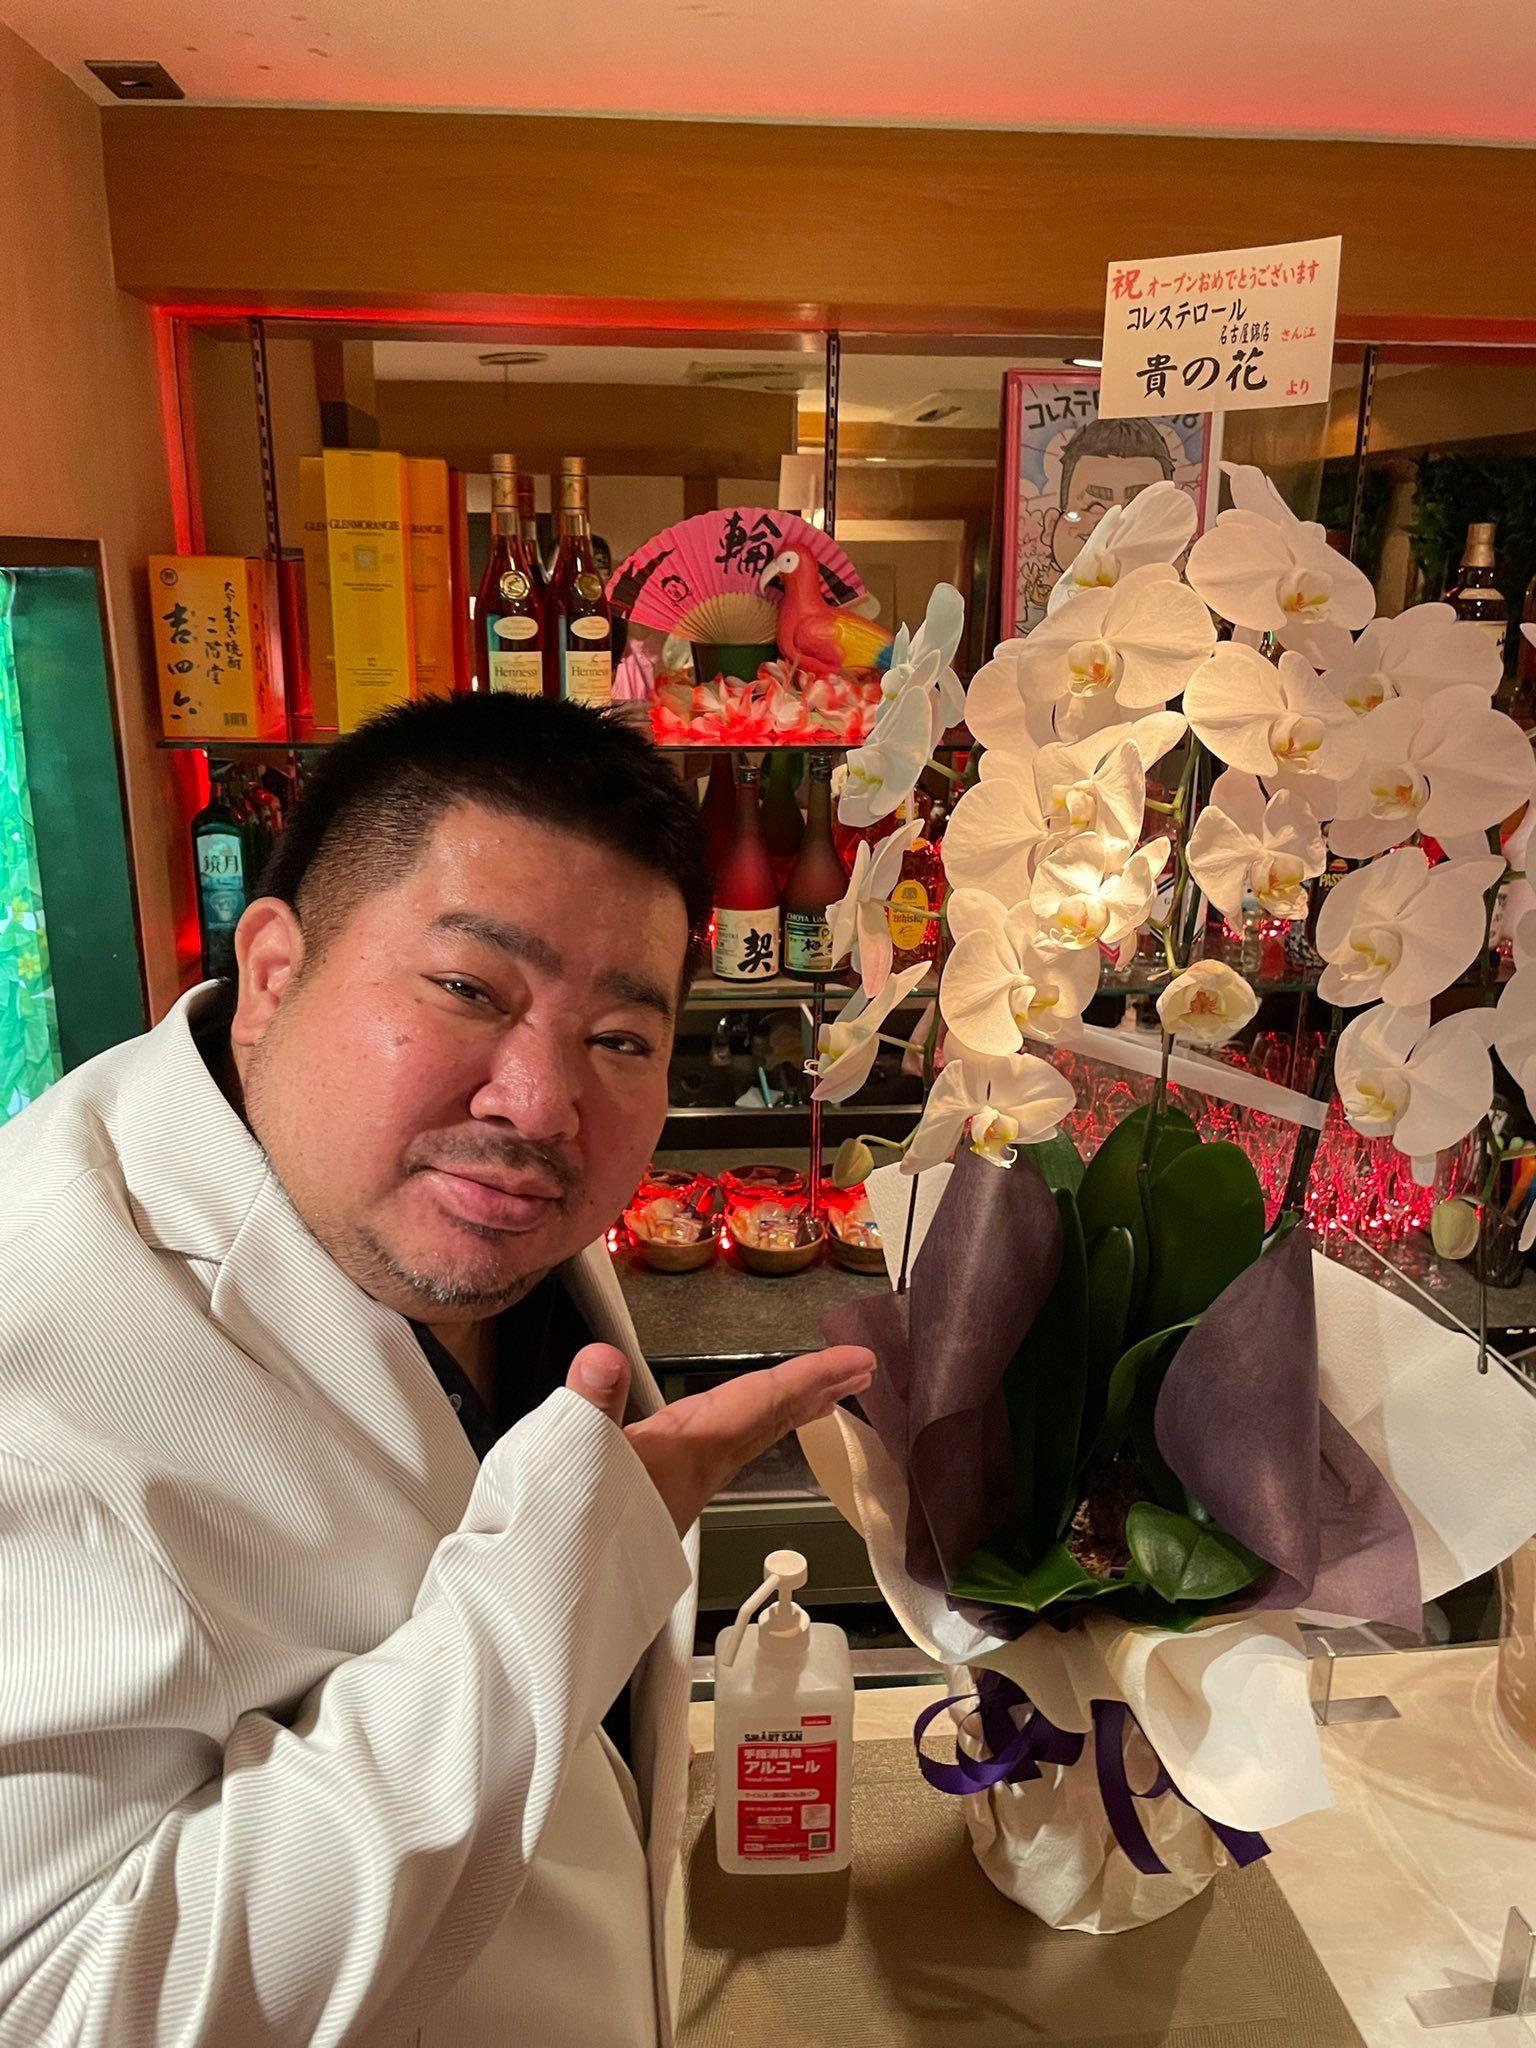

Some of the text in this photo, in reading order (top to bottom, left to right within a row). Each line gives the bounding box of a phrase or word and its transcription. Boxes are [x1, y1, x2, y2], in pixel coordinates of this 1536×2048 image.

[1111, 259, 1320, 301] 祝 オープンおめでとうございます
[1126, 298, 1248, 332] コレステロール
[1136, 346, 1311, 399] 貴の花 より
[714, 511, 783, 578] 輪
[203, 855, 239, 874] 鏡月
[737, 927, 774, 974] 契
[744, 1760, 821, 1775] アルコール
